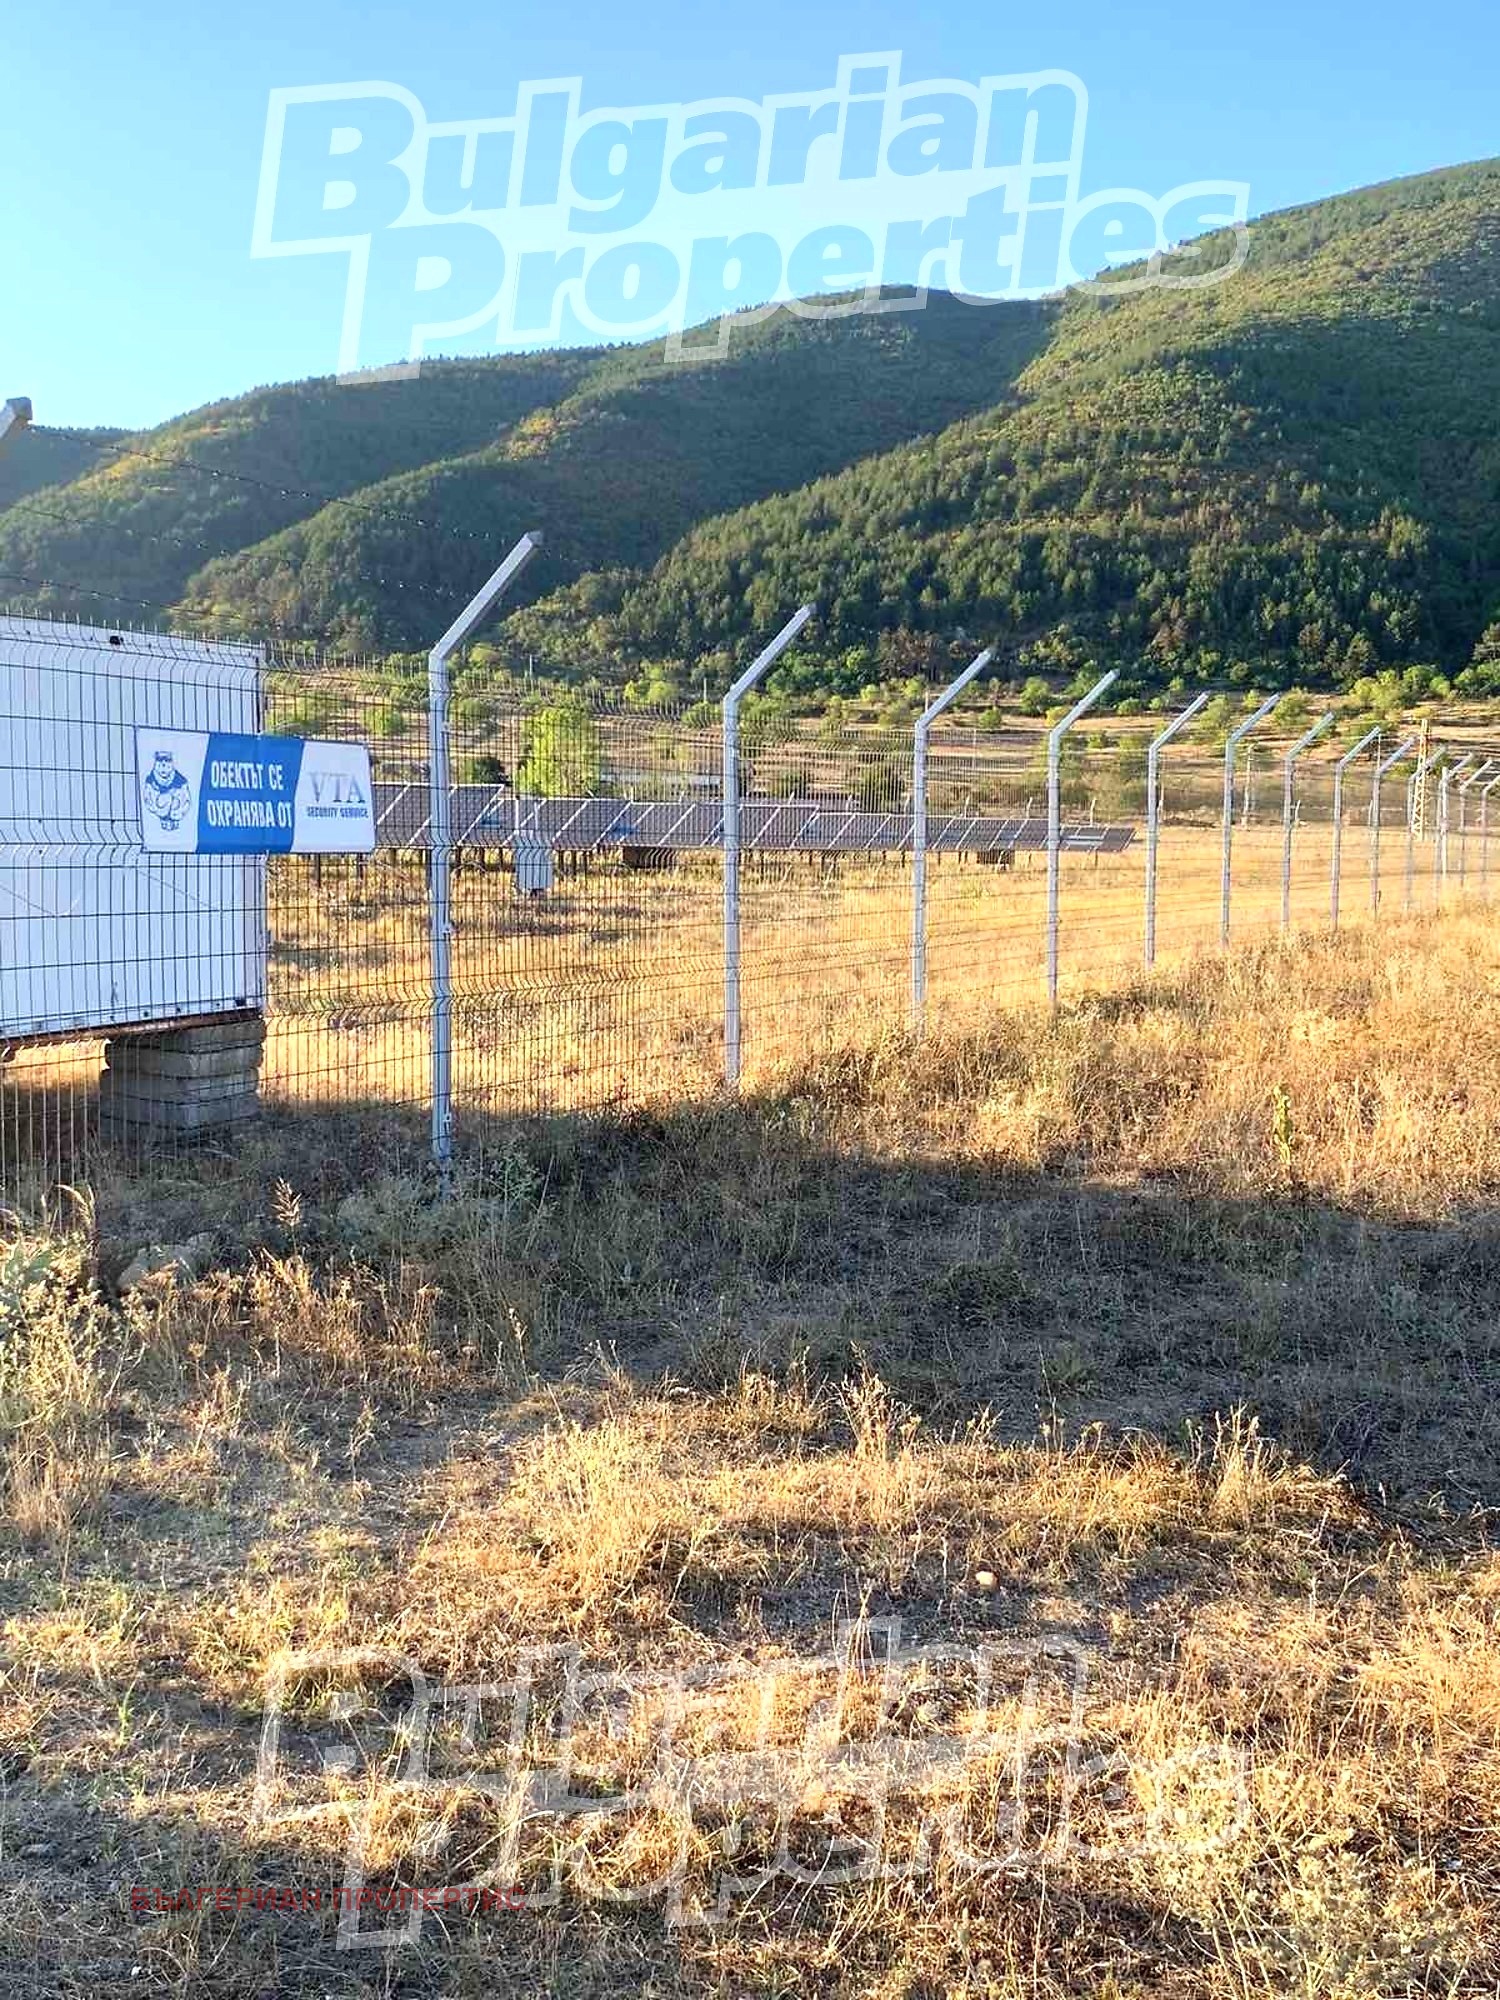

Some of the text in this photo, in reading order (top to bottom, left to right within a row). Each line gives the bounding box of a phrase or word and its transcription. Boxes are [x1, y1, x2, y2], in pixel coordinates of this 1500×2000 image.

[210, 760, 284, 791] ОБЕКТЪТ СЕ
[308, 772, 366, 804] VTA
[207, 799, 293, 829] ОХРАНЯВА ОТ
